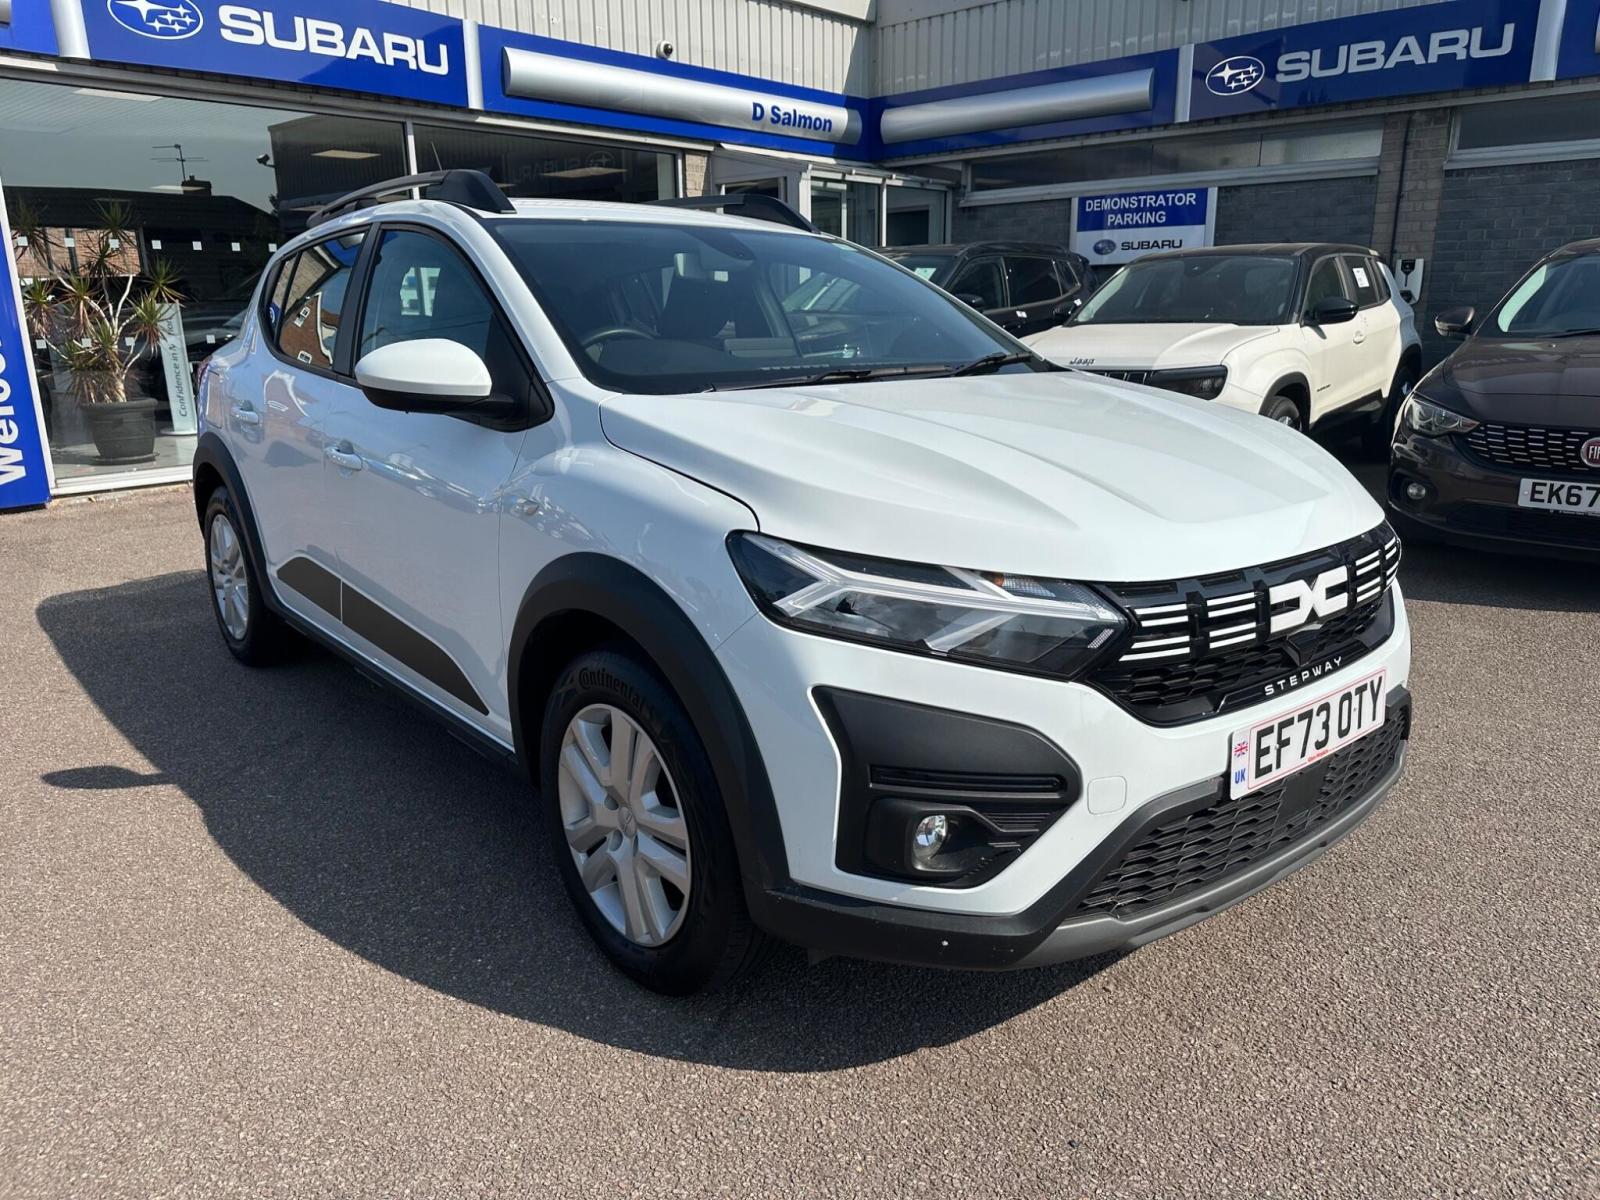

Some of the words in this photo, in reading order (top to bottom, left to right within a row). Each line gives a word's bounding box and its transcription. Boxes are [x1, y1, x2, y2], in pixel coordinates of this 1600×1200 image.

[218, 5, 449, 76] SUBARU
[1275, 23, 1515, 83] SUBARU
[752, 102, 765, 121] D
[770, 105, 833, 132] Salmon
[1085, 193, 1196, 212] DEMONSTRATOR
[1107, 211, 1166, 226] PARKING
[1121, 239, 1183, 251] SUBARU
[171, 352, 180, 362] in
[1069, 356, 1096, 366] Jeep
[173, 363, 188, 417] Confidence
[1530, 481, 1600, 509] EK67
[1264, 656, 1342, 695] STEPWAY
[578, 666, 647, 715] Continental
[1255, 701, 1331, 779] EF73
[1337, 676, 1383, 739] OTY
[1234, 768, 1246, 784] UK
